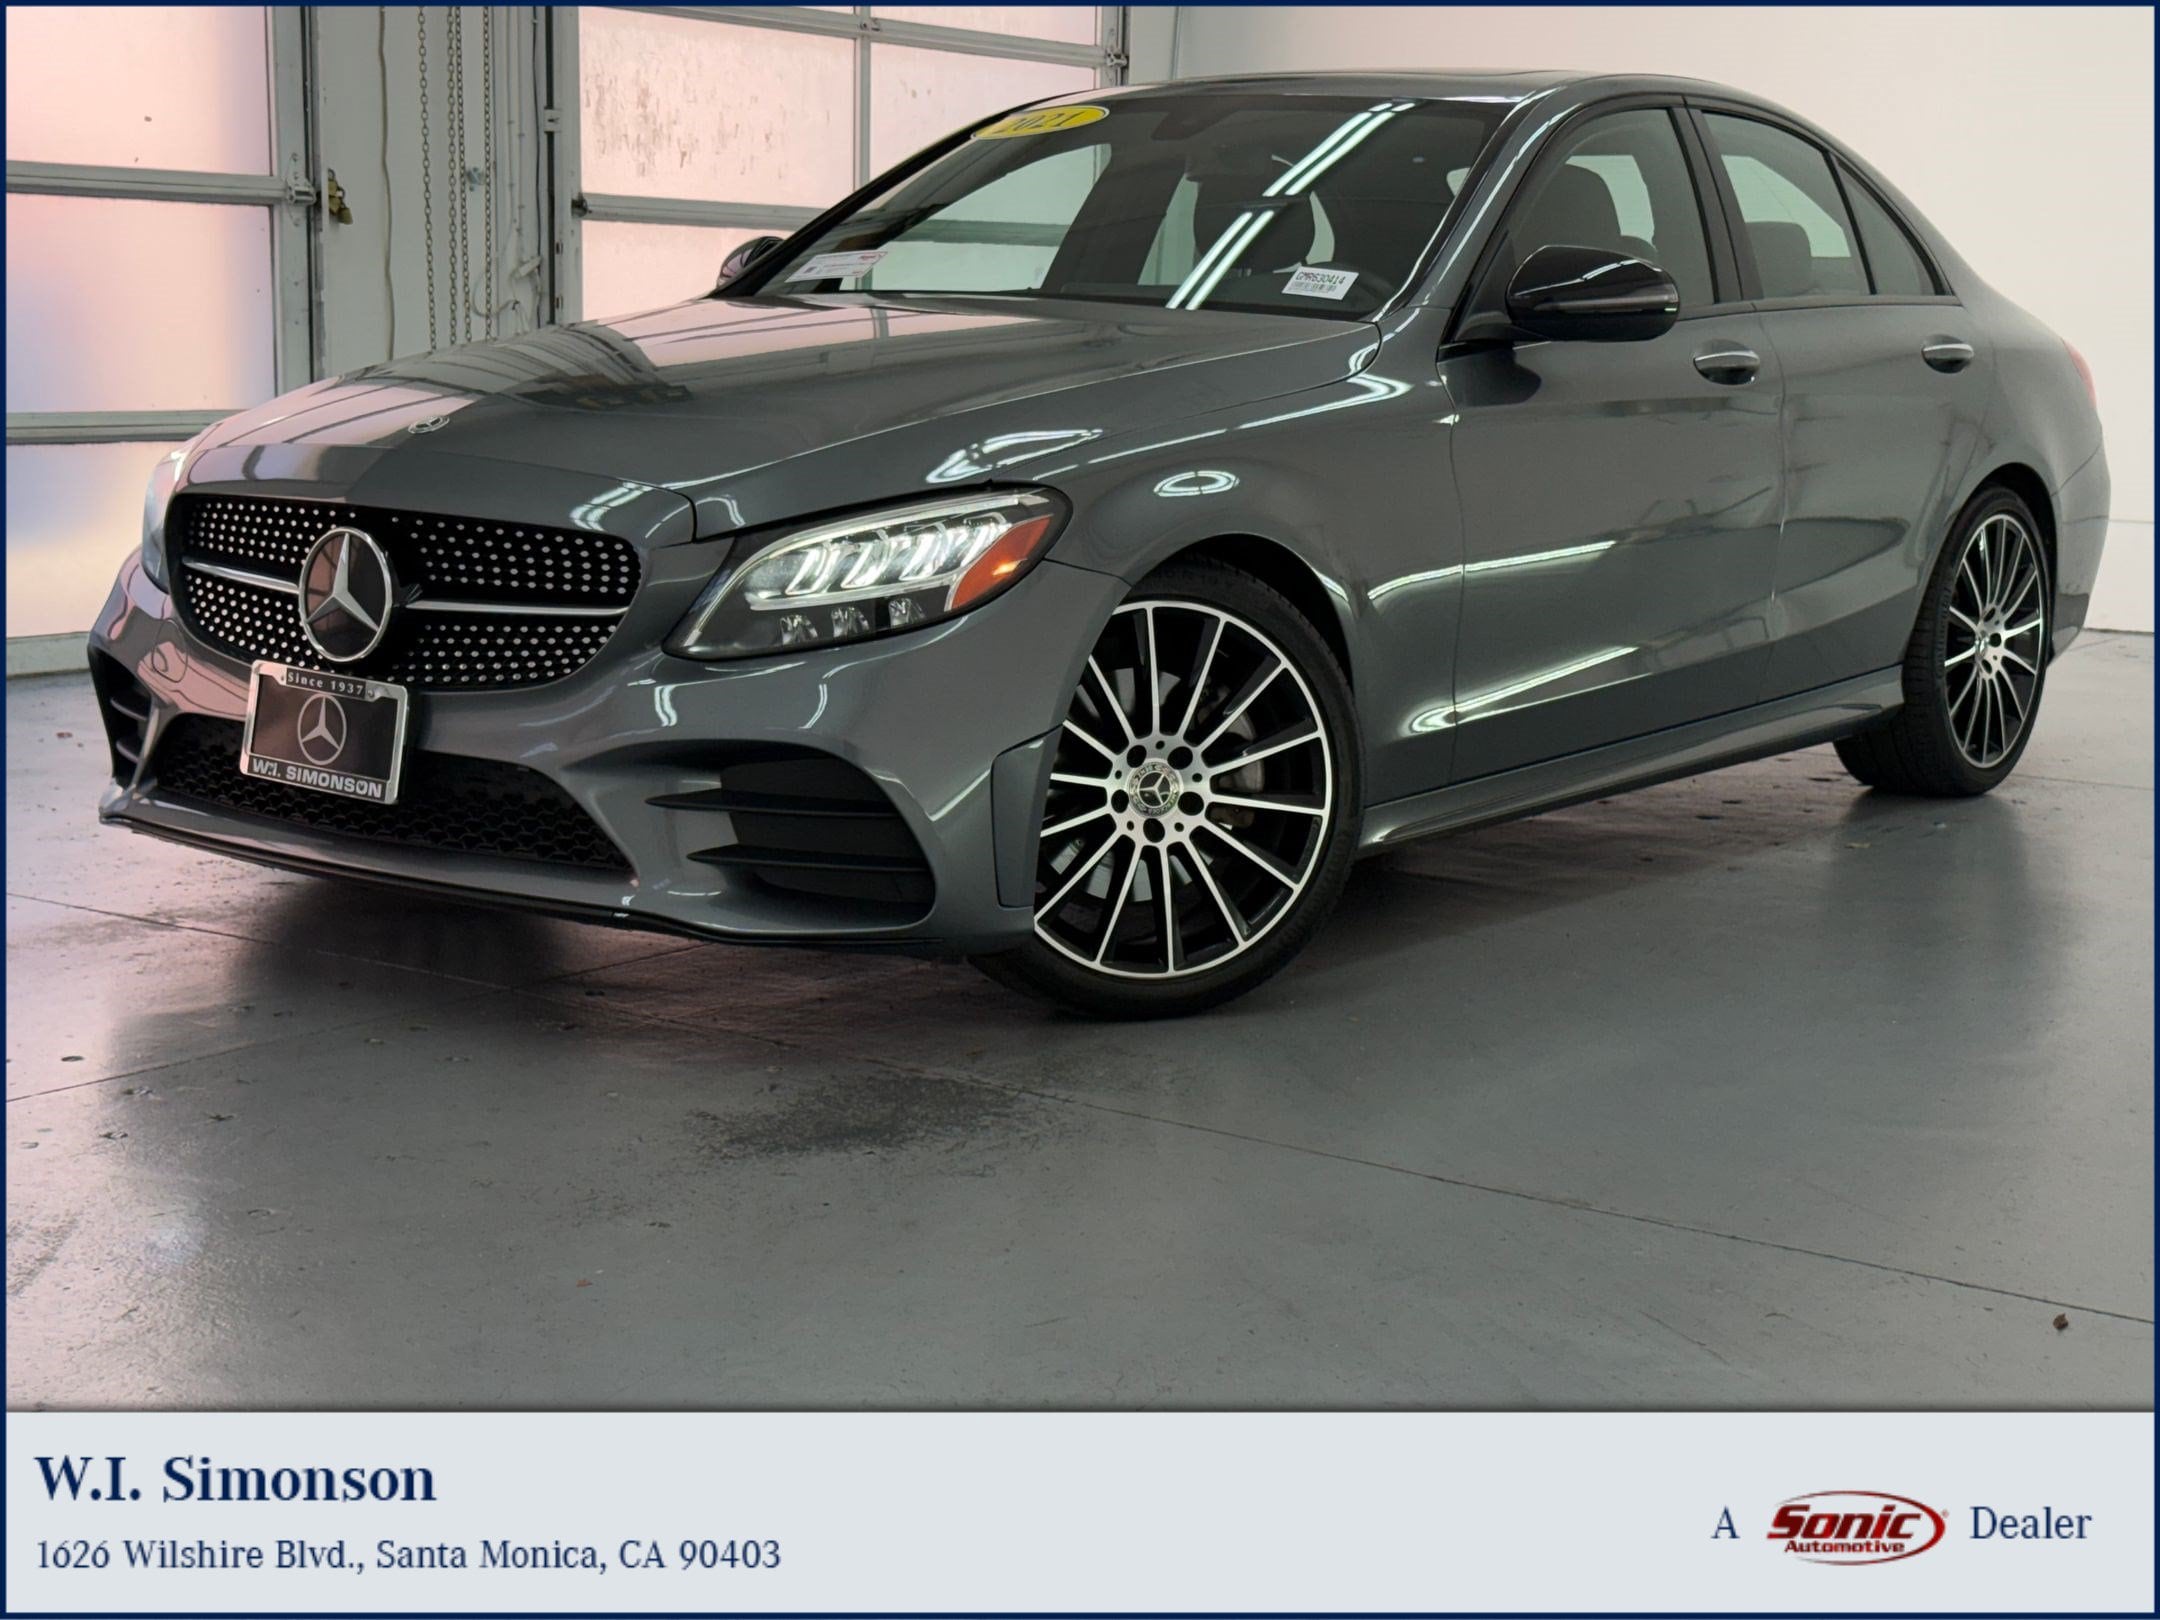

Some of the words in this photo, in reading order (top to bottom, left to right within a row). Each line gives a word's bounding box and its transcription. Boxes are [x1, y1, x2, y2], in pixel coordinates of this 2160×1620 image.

[990, 110, 1085, 134] 2021
[286, 671, 324, 688] Since
[330, 677, 364, 695] 1937
[252, 757, 281, 778] W.I.
[286, 765, 383, 799] SIMONSON
